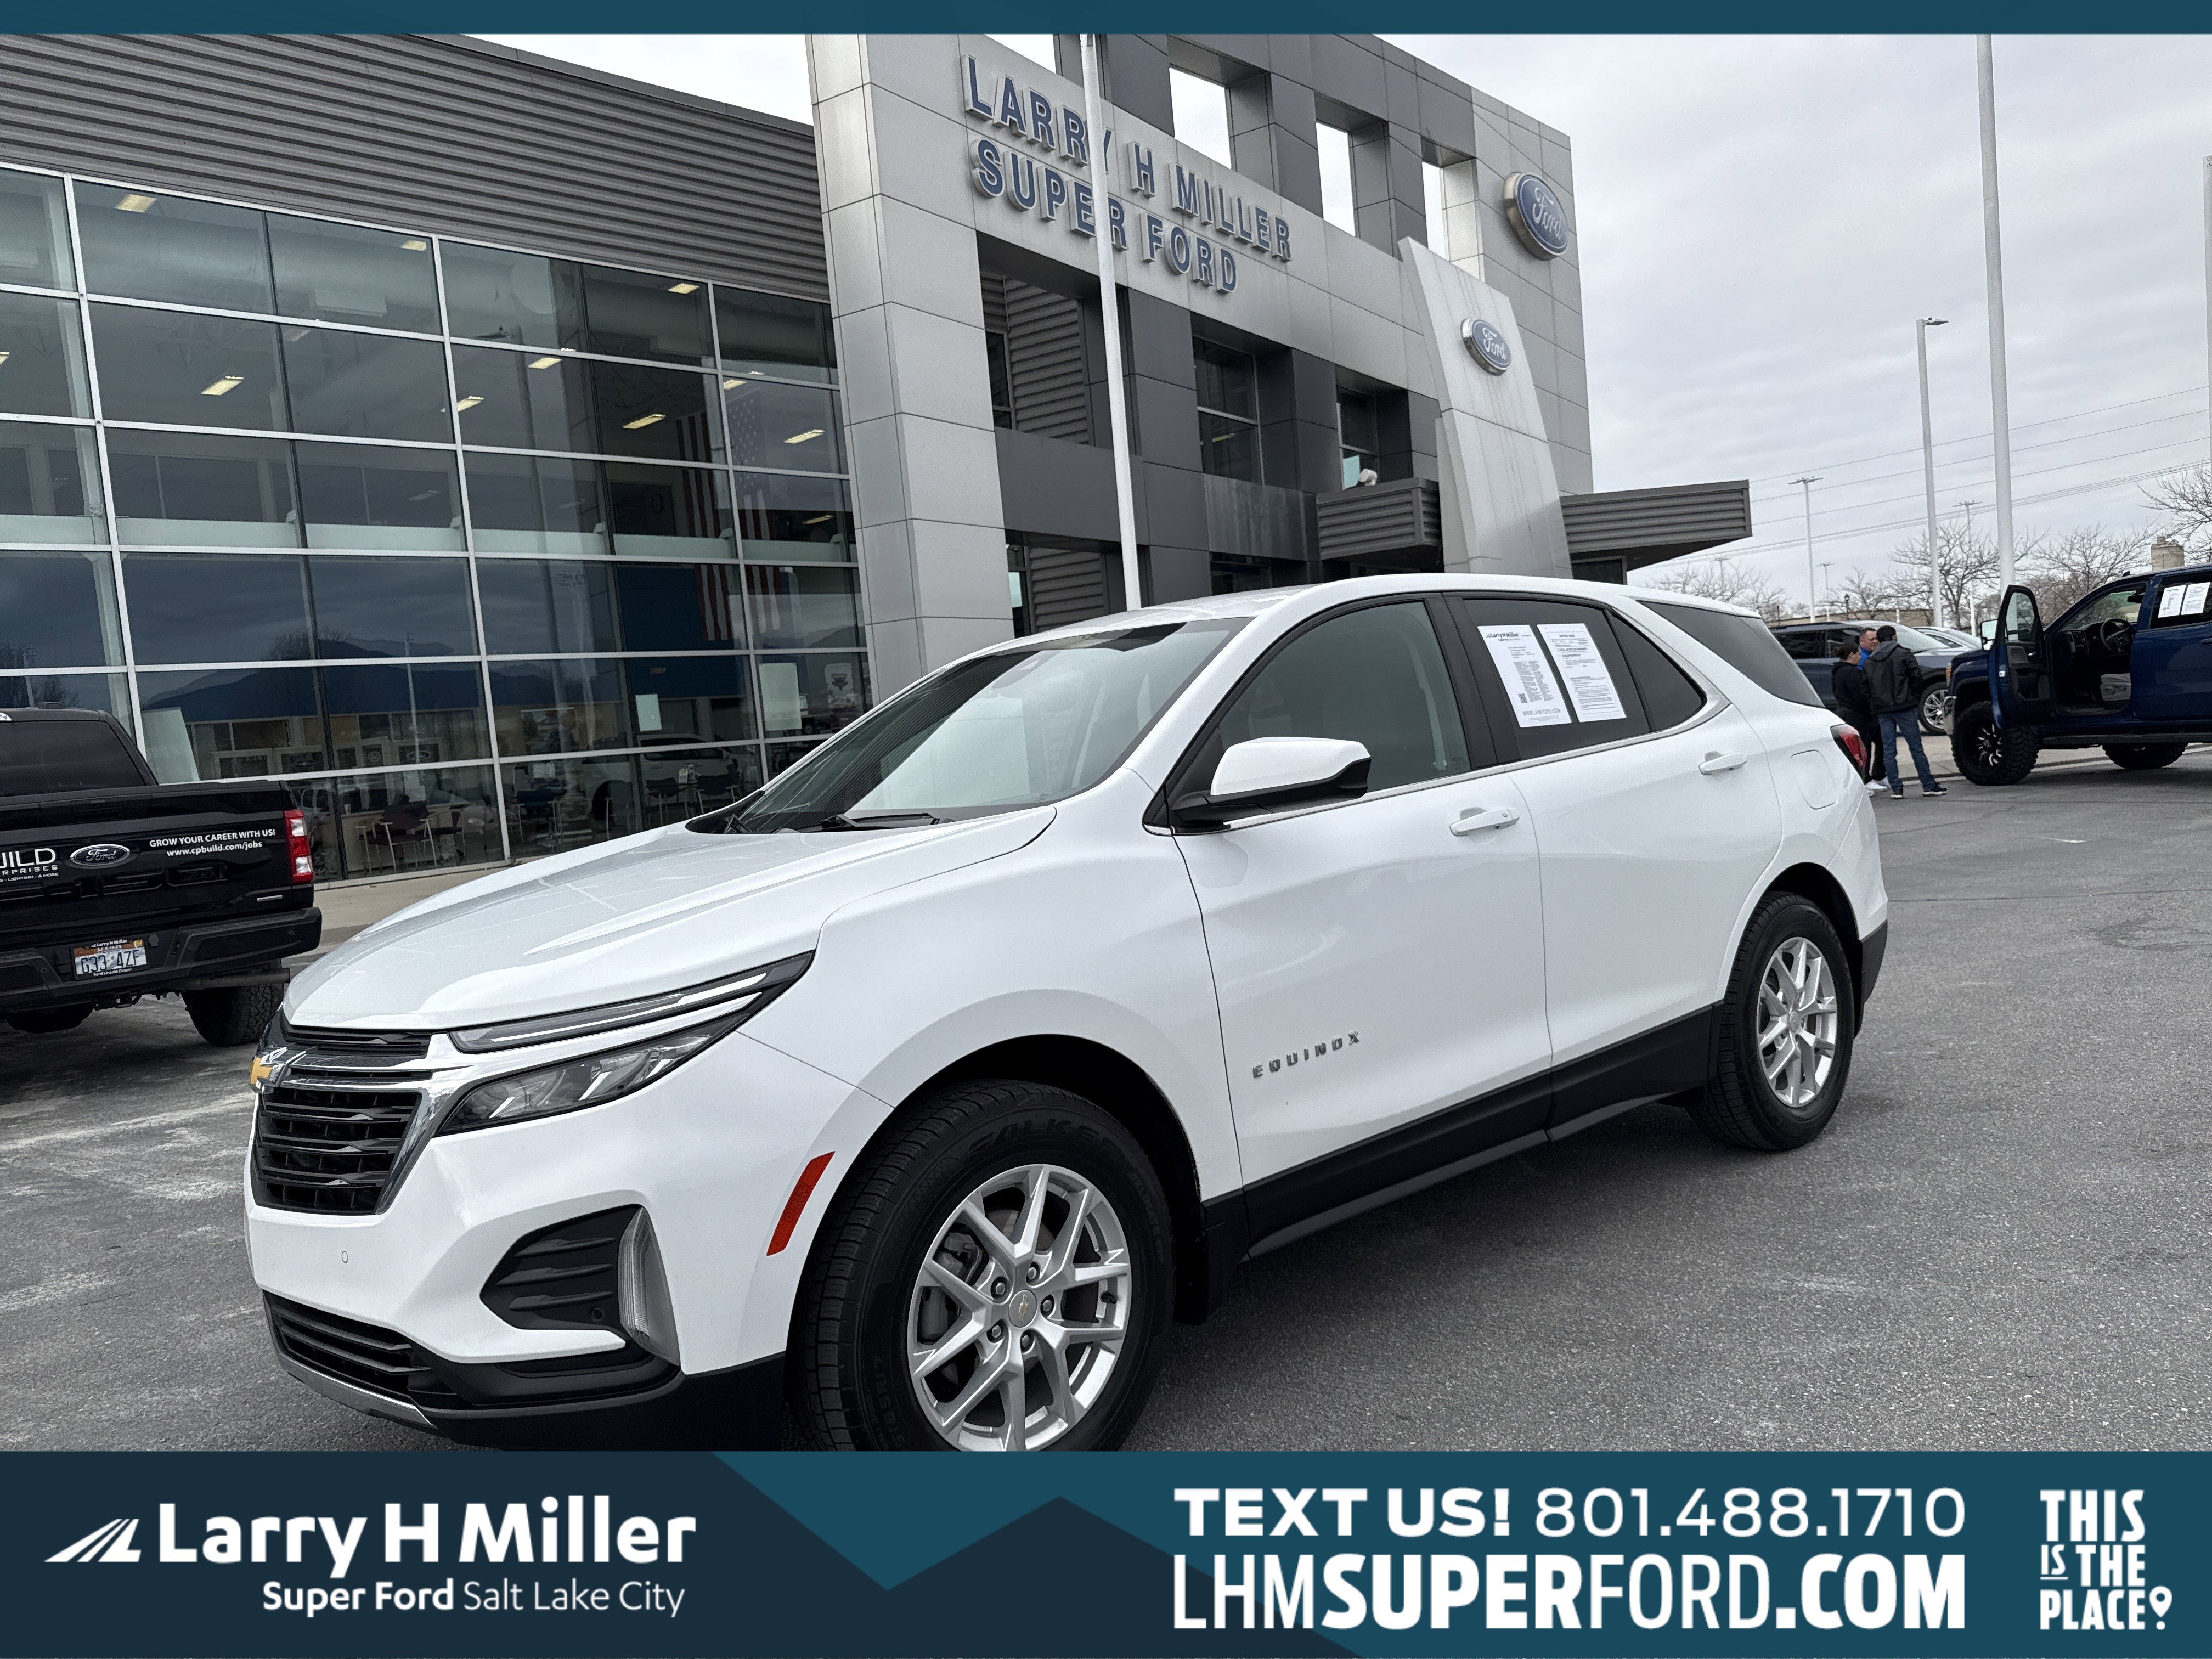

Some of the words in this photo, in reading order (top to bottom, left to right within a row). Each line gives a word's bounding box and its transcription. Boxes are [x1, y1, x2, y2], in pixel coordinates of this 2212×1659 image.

[970, 137, 1128, 251] SUPER
[1140, 212, 1237, 295] FORD
[1127, 140, 1155, 198] H
[1169, 162, 1292, 262] MILLER
[1532, 187, 1563, 240] Ford
[1482, 327, 1506, 360] Ford
[149, 838, 177, 847] GROW
[179, 835, 204, 845] YOUR
[205, 832, 238, 842] CAREER
[238, 830, 261, 839] WITH
[262, 828, 275, 837] US!
[167, 840, 263, 856] www.cpbuild.com/jobs
[86, 849, 117, 862] Ford
[81, 955, 107, 973] G33
[117, 950, 139, 967] 4ZF
[1252, 1031, 1359, 1079] EQUINOX
